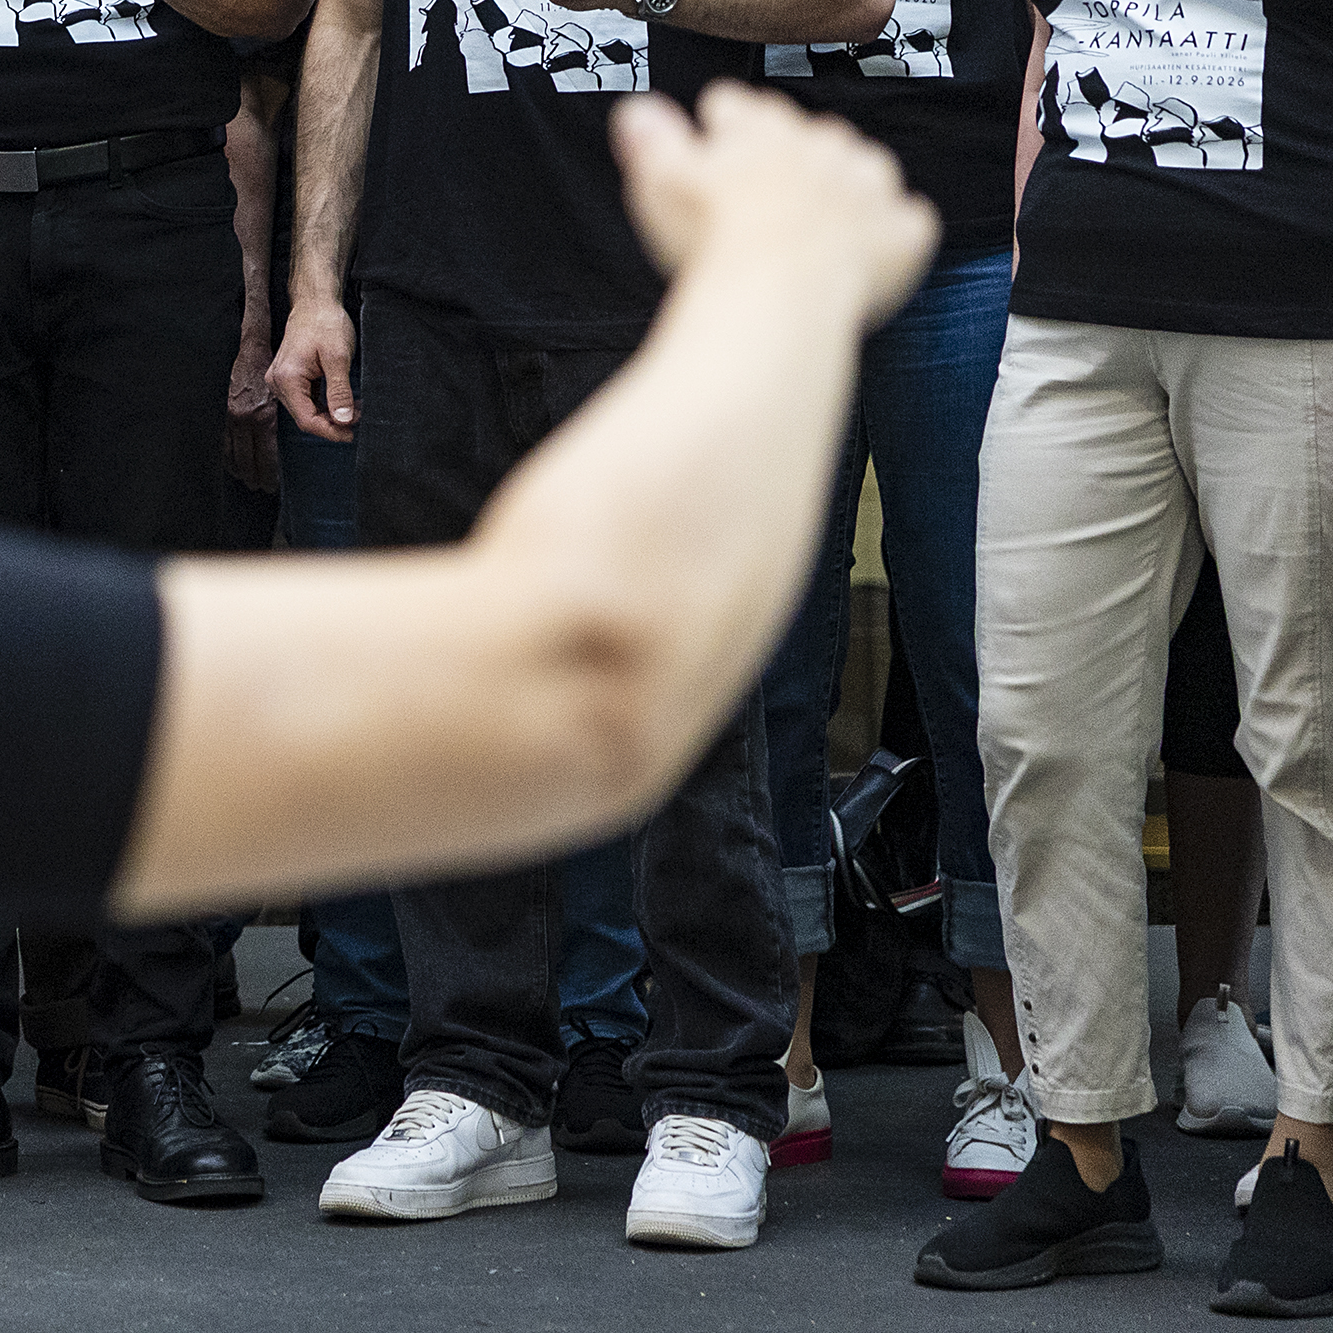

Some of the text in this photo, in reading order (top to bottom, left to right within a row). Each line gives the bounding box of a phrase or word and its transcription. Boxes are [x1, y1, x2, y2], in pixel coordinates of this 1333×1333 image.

[1083, 0, 1185, 21] TOPPILA
[1078, 29, 1248, 51] -KANTAATTI
[1143, 74, 1245, 87] 11.-12.9.2026
